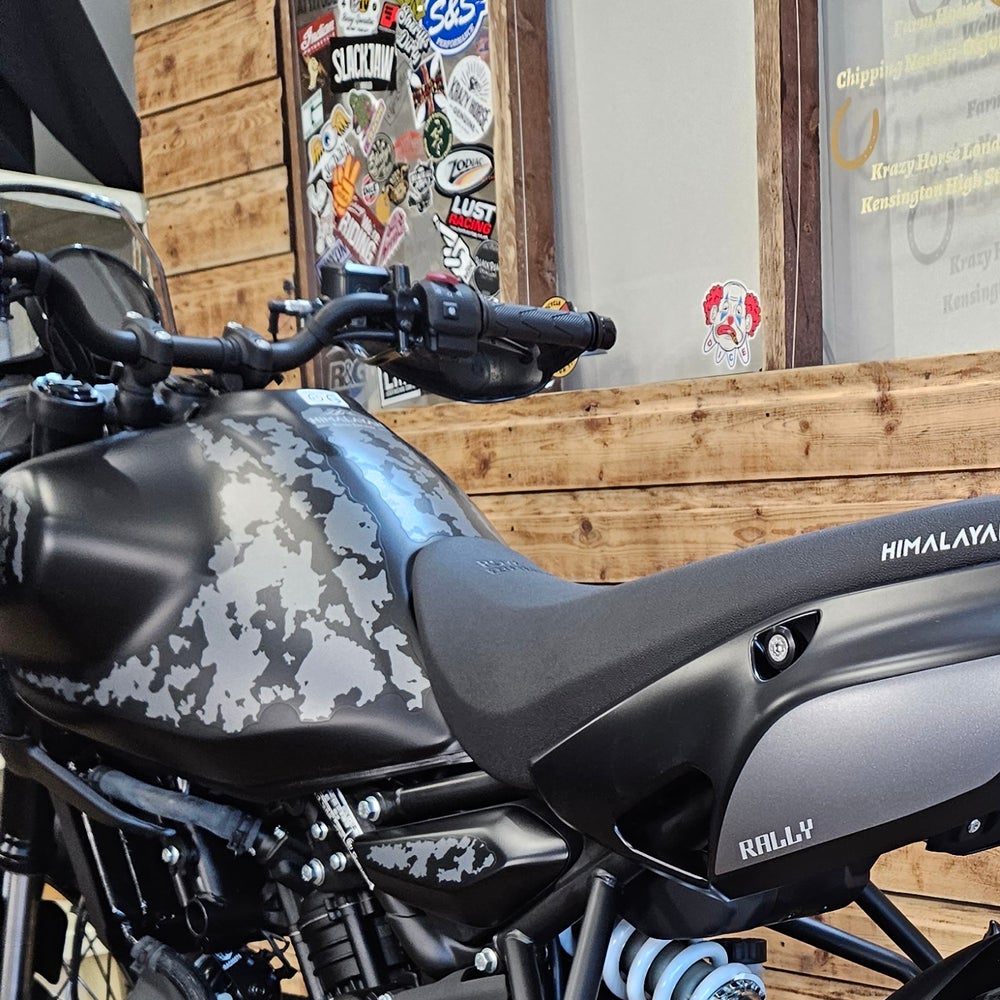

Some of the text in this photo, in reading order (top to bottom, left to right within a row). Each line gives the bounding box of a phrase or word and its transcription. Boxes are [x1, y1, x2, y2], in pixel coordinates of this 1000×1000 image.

[332, 43, 394, 84] SLACKJAW
[836, 59, 904, 89] Chipping
[870, 156, 915, 182] Krazy
[916, 146, 961, 171] Horse
[451, 195, 496, 224] LUST
[860, 185, 944, 215] Kensington
[945, 171, 983, 197] High
[448, 213, 492, 235] RACING
[950, 250, 993, 275] Krazy
[739, 818, 814, 860] RALLY
